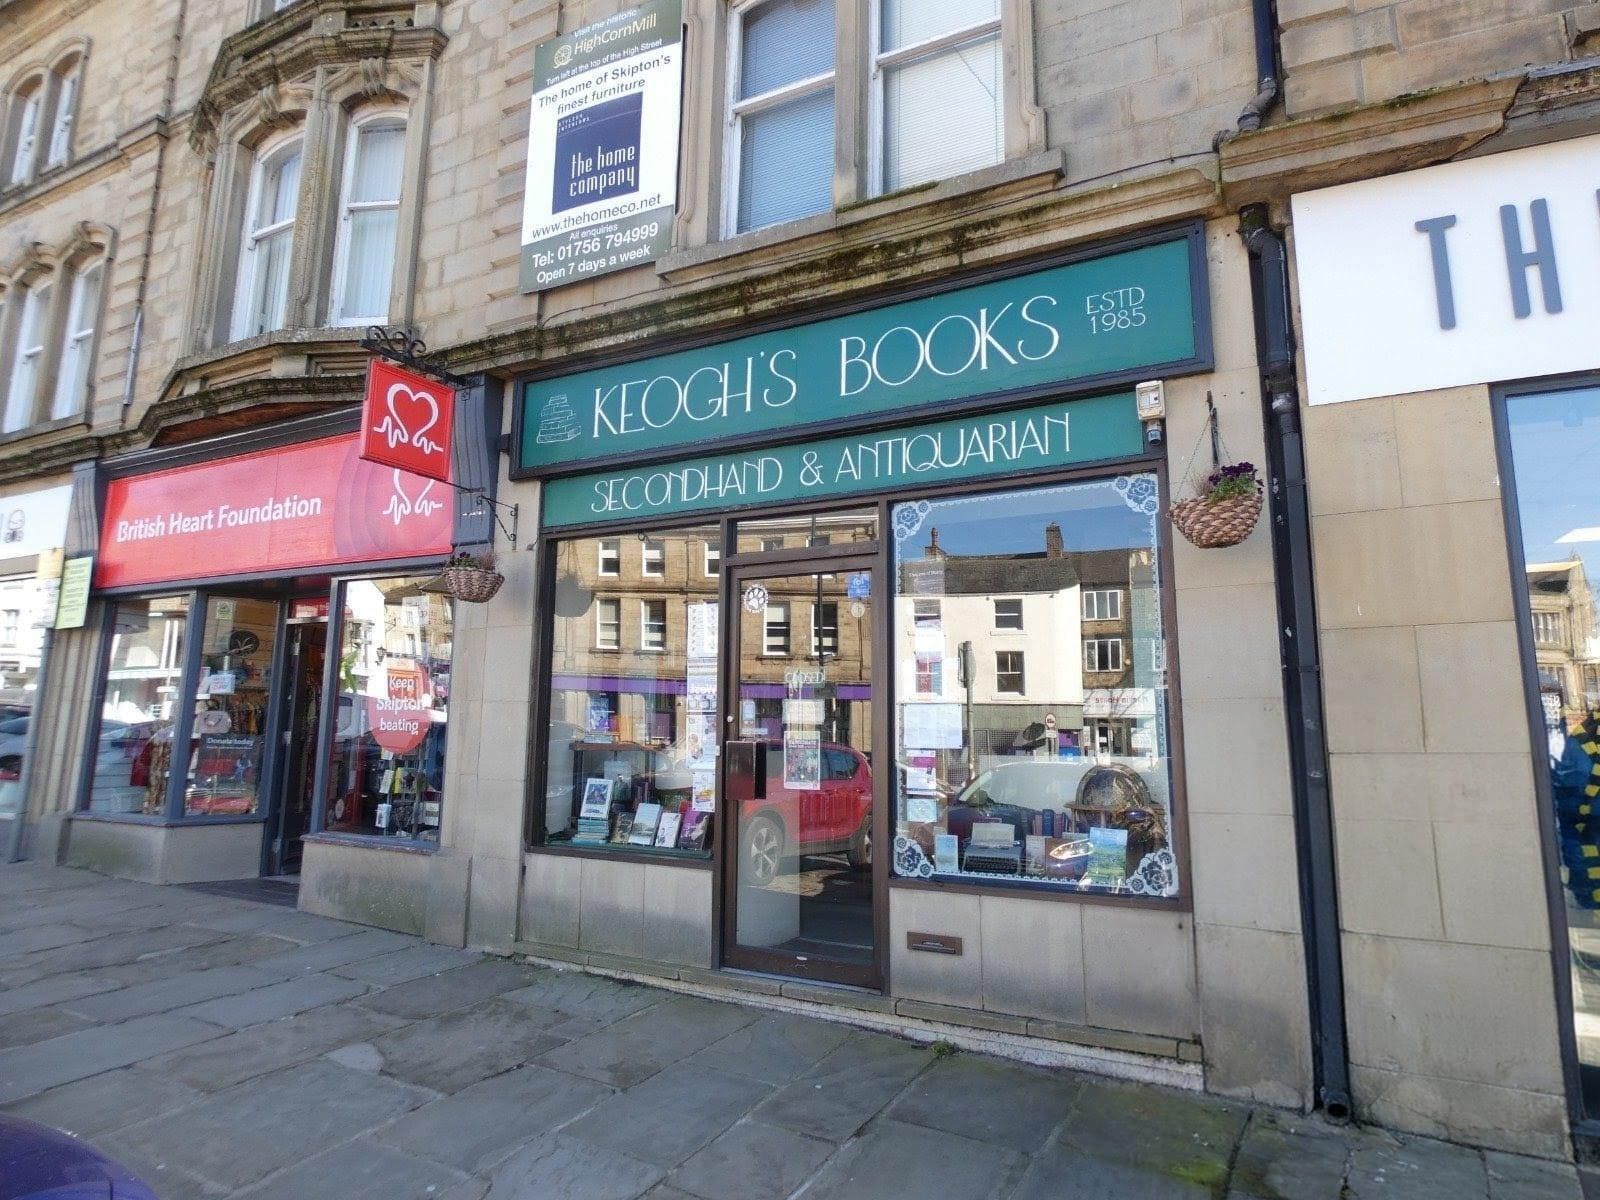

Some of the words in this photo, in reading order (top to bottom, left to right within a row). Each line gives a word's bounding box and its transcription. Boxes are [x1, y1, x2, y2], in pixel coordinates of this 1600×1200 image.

[574, 13, 657, 55] HighCornMill
[592, 21, 605, 31] the
[578, 63, 589, 73] the
[602, 54, 610, 63] of
[610, 51, 621, 60] the
[623, 45, 639, 57] High
[640, 38, 662, 51] Street
[539, 94, 558, 108] The
[561, 80, 592, 98] home
[596, 70, 609, 85] of
[611, 54, 671, 80] Skipton's
[557, 96, 588, 115] finest
[592, 78, 646, 101] furniture
[571, 152, 593, 179] the
[597, 146, 635, 170] home
[570, 166, 635, 197] company
[532, 192, 662, 239] www.thehomeco.net
[569, 231, 580, 241] All
[581, 224, 618, 239] enquiries
[532, 251, 555, 268] Tel:
[557, 238, 601, 261] 01756
[605, 222, 659, 250] 794999
[1414, 188, 1600, 331] TH
[536, 267, 566, 284] Open
[568, 263, 575, 275] 7
[578, 258, 606, 276] days
[609, 256, 617, 266] a
[619, 244, 651, 262] week
[1085, 286, 1146, 315] ESTD
[1089, 306, 1147, 335] 1985
[592, 349, 797, 438] KEOGH'S
[840, 295, 1060, 397] BOOKS
[591, 456, 783, 512] SECONDHAND
[800, 450, 824, 486] &
[834, 412, 1071, 483] ANTIQUARIAN
[116, 514, 165, 543] British
[169, 511, 214, 535] Heart
[217, 494, 322, 529] Foundation
[389, 675, 414, 692] Keep
[380, 717, 419, 736] beating
